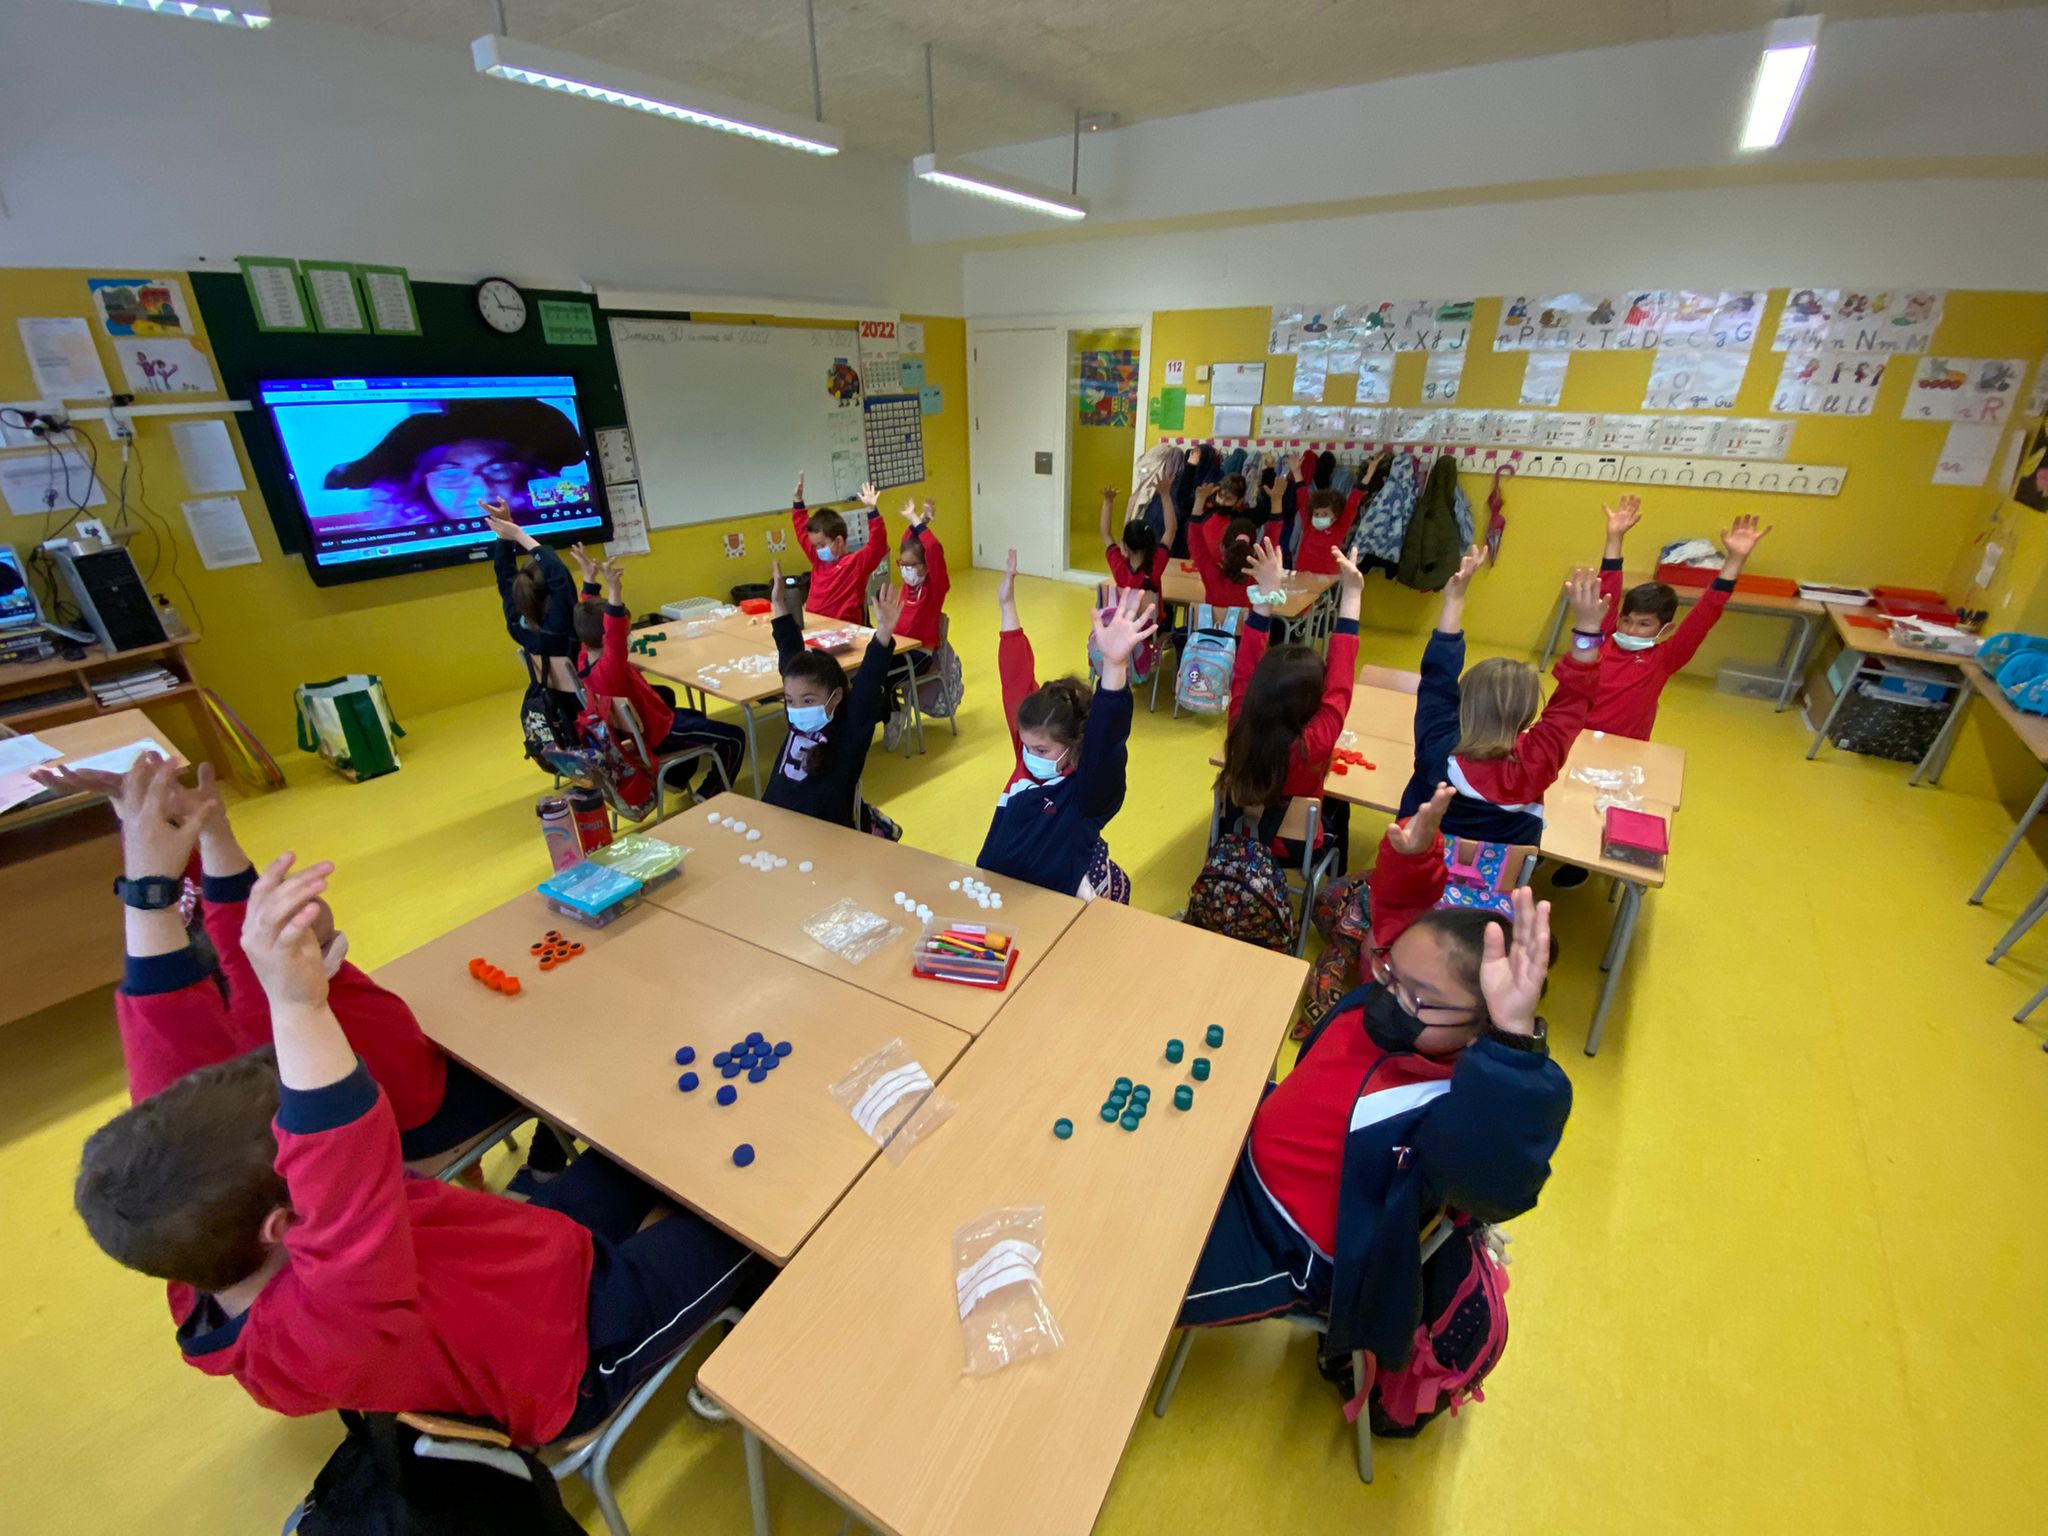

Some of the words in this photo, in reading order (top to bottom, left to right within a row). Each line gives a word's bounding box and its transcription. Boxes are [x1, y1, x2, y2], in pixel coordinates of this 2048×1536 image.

[861, 320, 895, 339] 2022
[1449, 327, 1467, 350] J
[1518, 326, 1535, 345] P
[1600, 329, 1613, 348] T
[1735, 322, 1751, 342] G
[1381, 331, 1396, 351] X
[1414, 329, 1430, 350] X
[1642, 330, 1658, 349] D
[1855, 330, 1878, 350] N
[1906, 334, 1929, 350] M
[1168, 362, 1182, 372] 112
[1979, 397, 2004, 421] R
